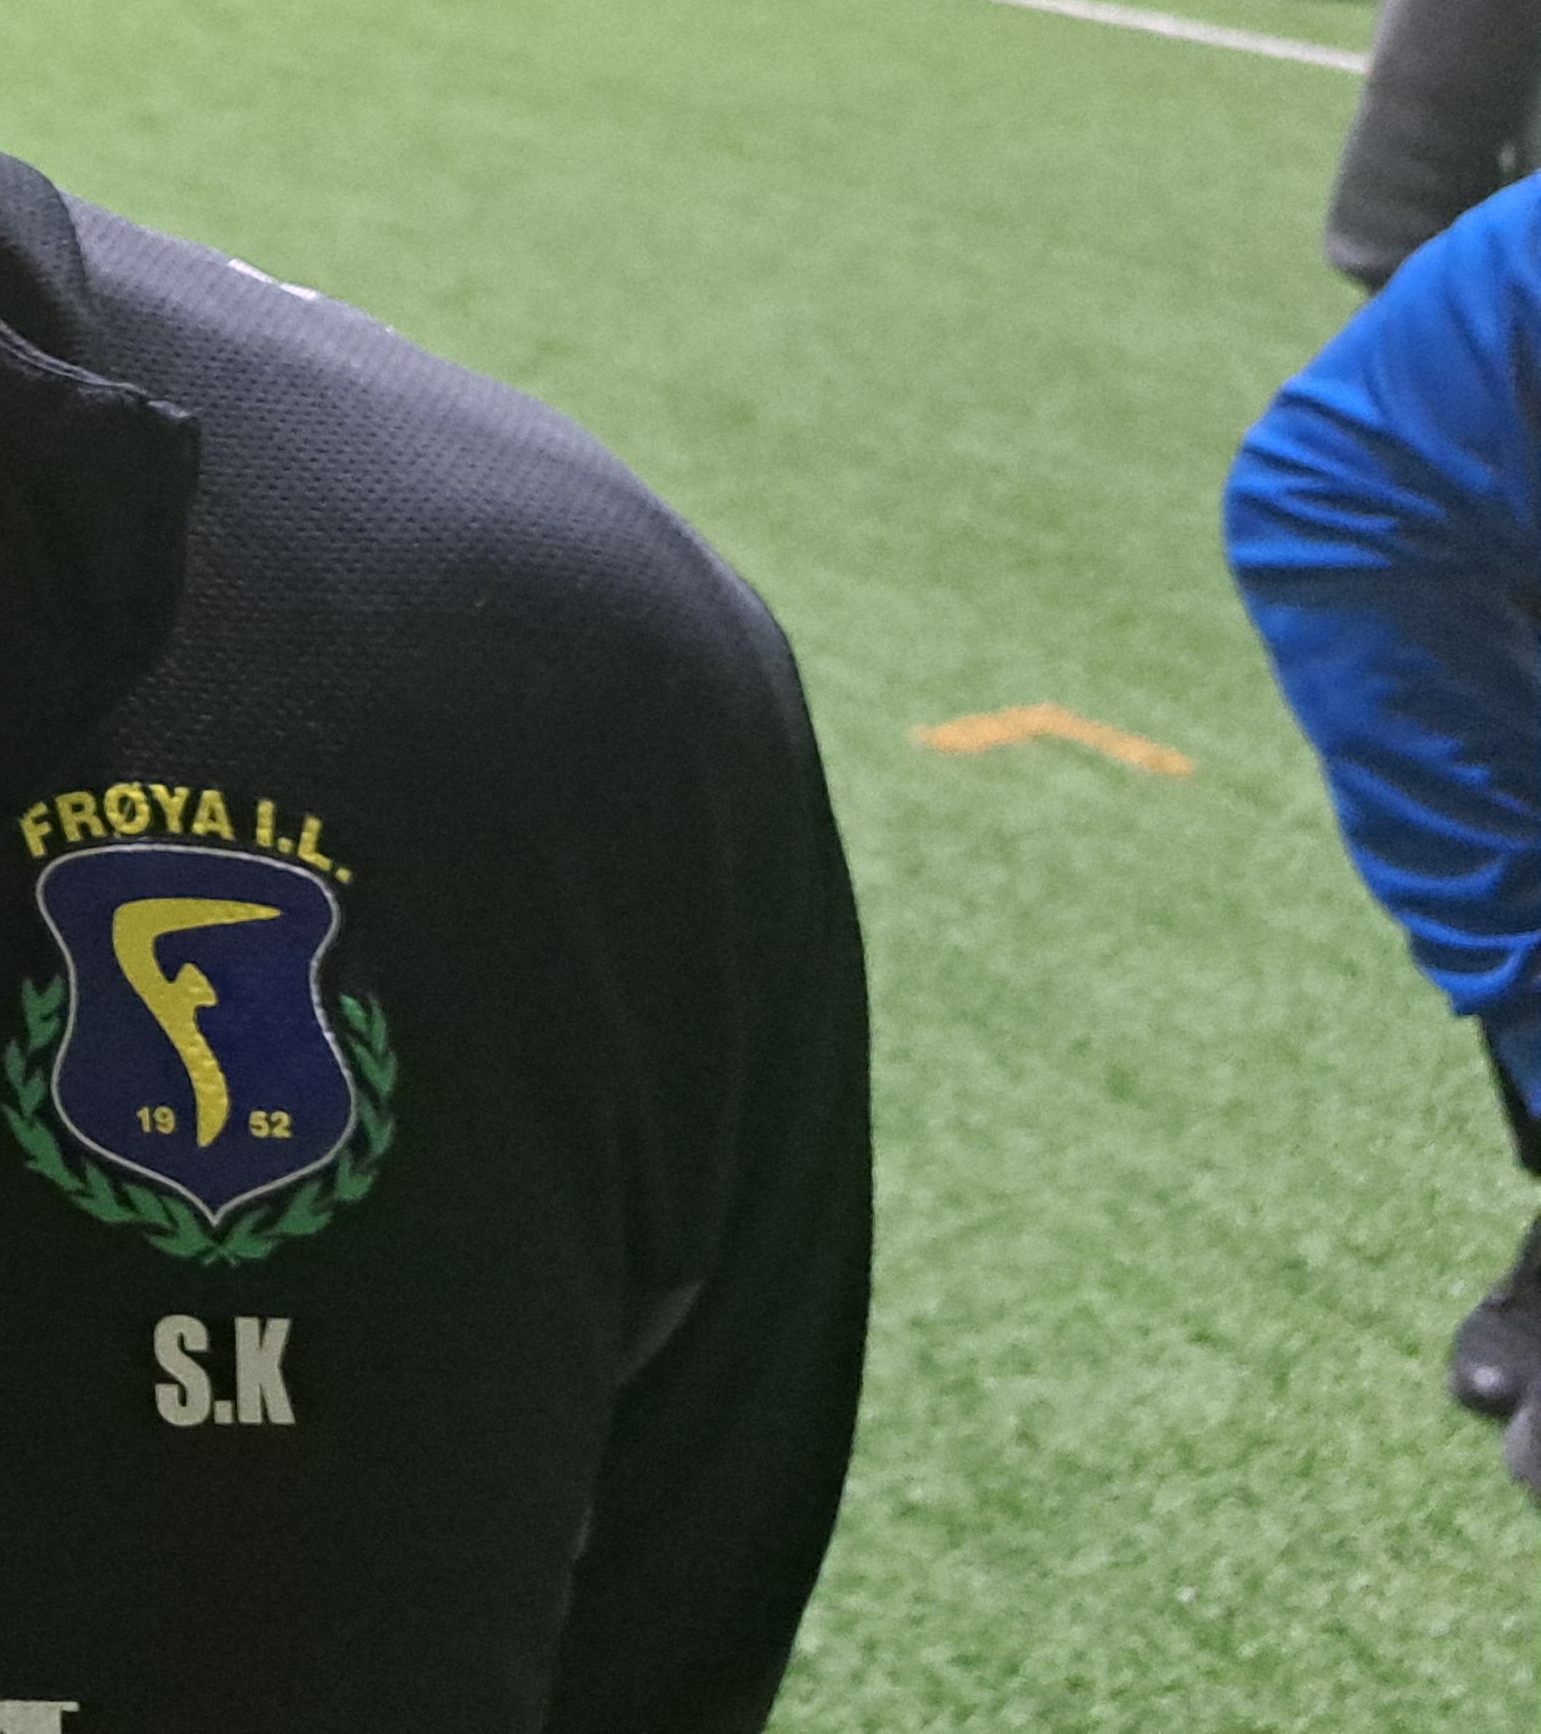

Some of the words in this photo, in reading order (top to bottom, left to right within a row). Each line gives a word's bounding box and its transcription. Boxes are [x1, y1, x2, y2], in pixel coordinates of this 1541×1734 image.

[20, 781, 236, 858] FRØYA
[136, 1106, 176, 1134] 19
[248, 1110, 292, 1138] 52
[153, 1313, 296, 1427] S.K
